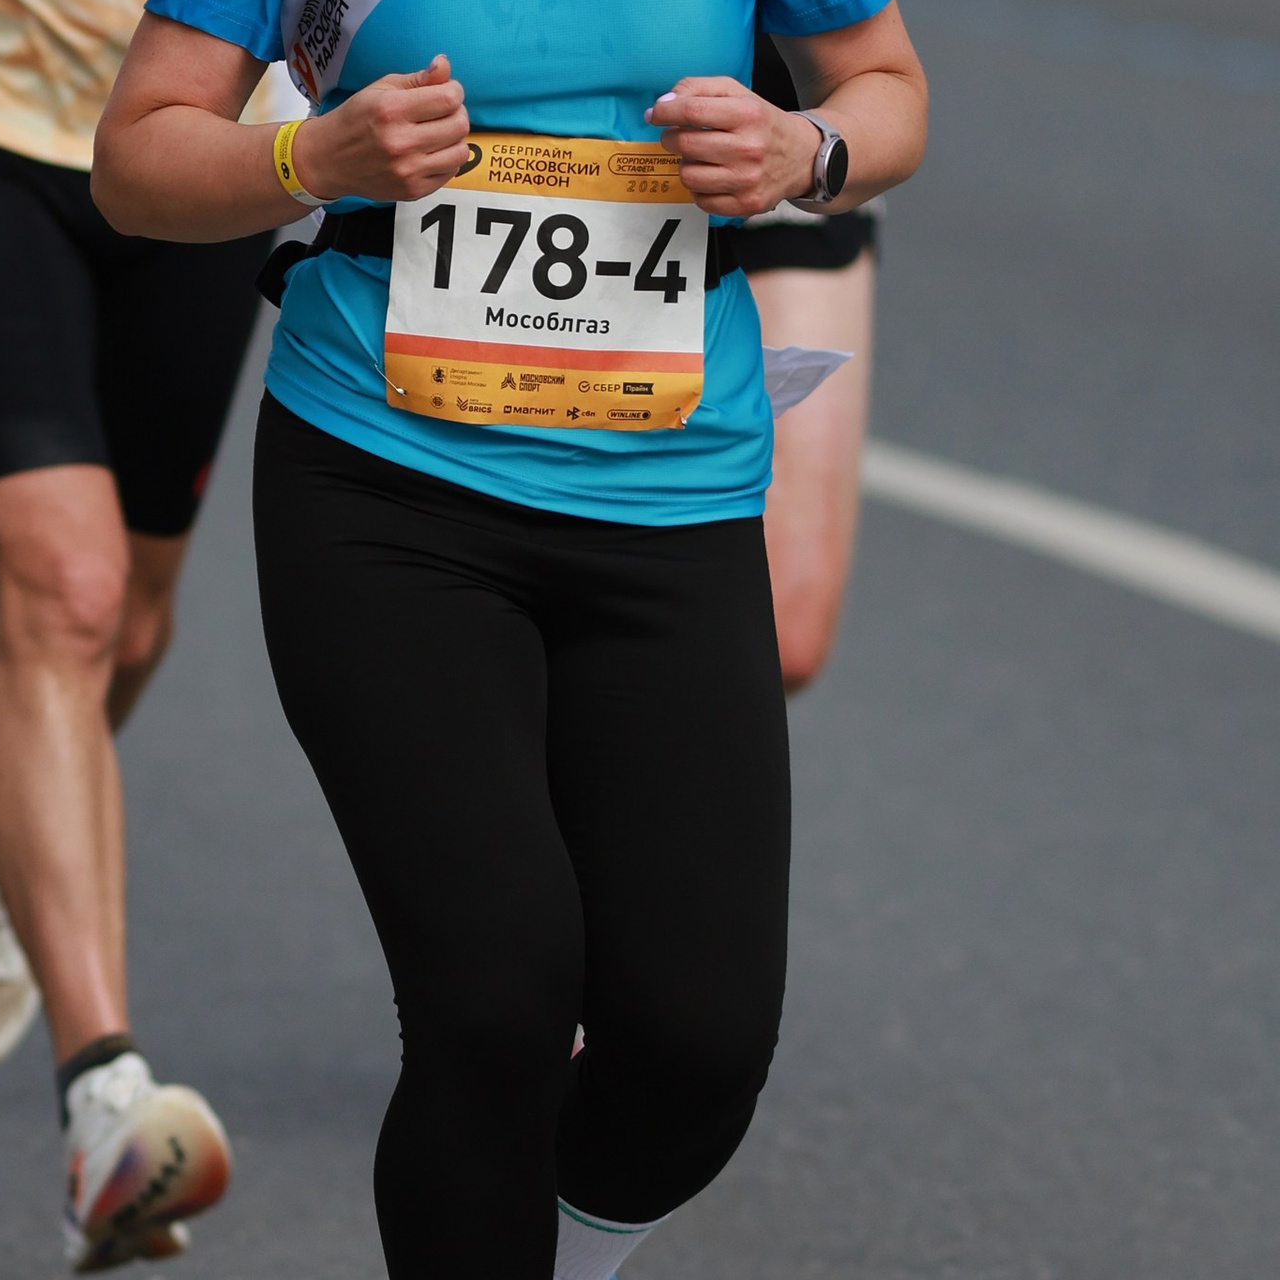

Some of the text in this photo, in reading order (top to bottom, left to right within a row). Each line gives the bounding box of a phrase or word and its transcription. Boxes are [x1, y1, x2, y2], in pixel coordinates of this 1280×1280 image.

[492, 144, 572, 159] СБЕРПРАЙМ
[490, 156, 600, 176] МОСКОВСКИЙ
[616, 164, 655, 173] ЭСТАФЕТА
[488, 170, 570, 187] МАРАФОН
[626, 179, 670, 193] 2026
[420, 203, 687, 304] 178-4
[485, 307, 610, 334] Мособлгаз
[520, 373, 565, 385] МОСКОВСКИЙ
[519, 383, 541, 392] СПОРТ
[593, 383, 649, 393] СБЕР Прайм
[468, 405, 492, 414] BRICS
[610, 411, 642, 419] WINLINE
